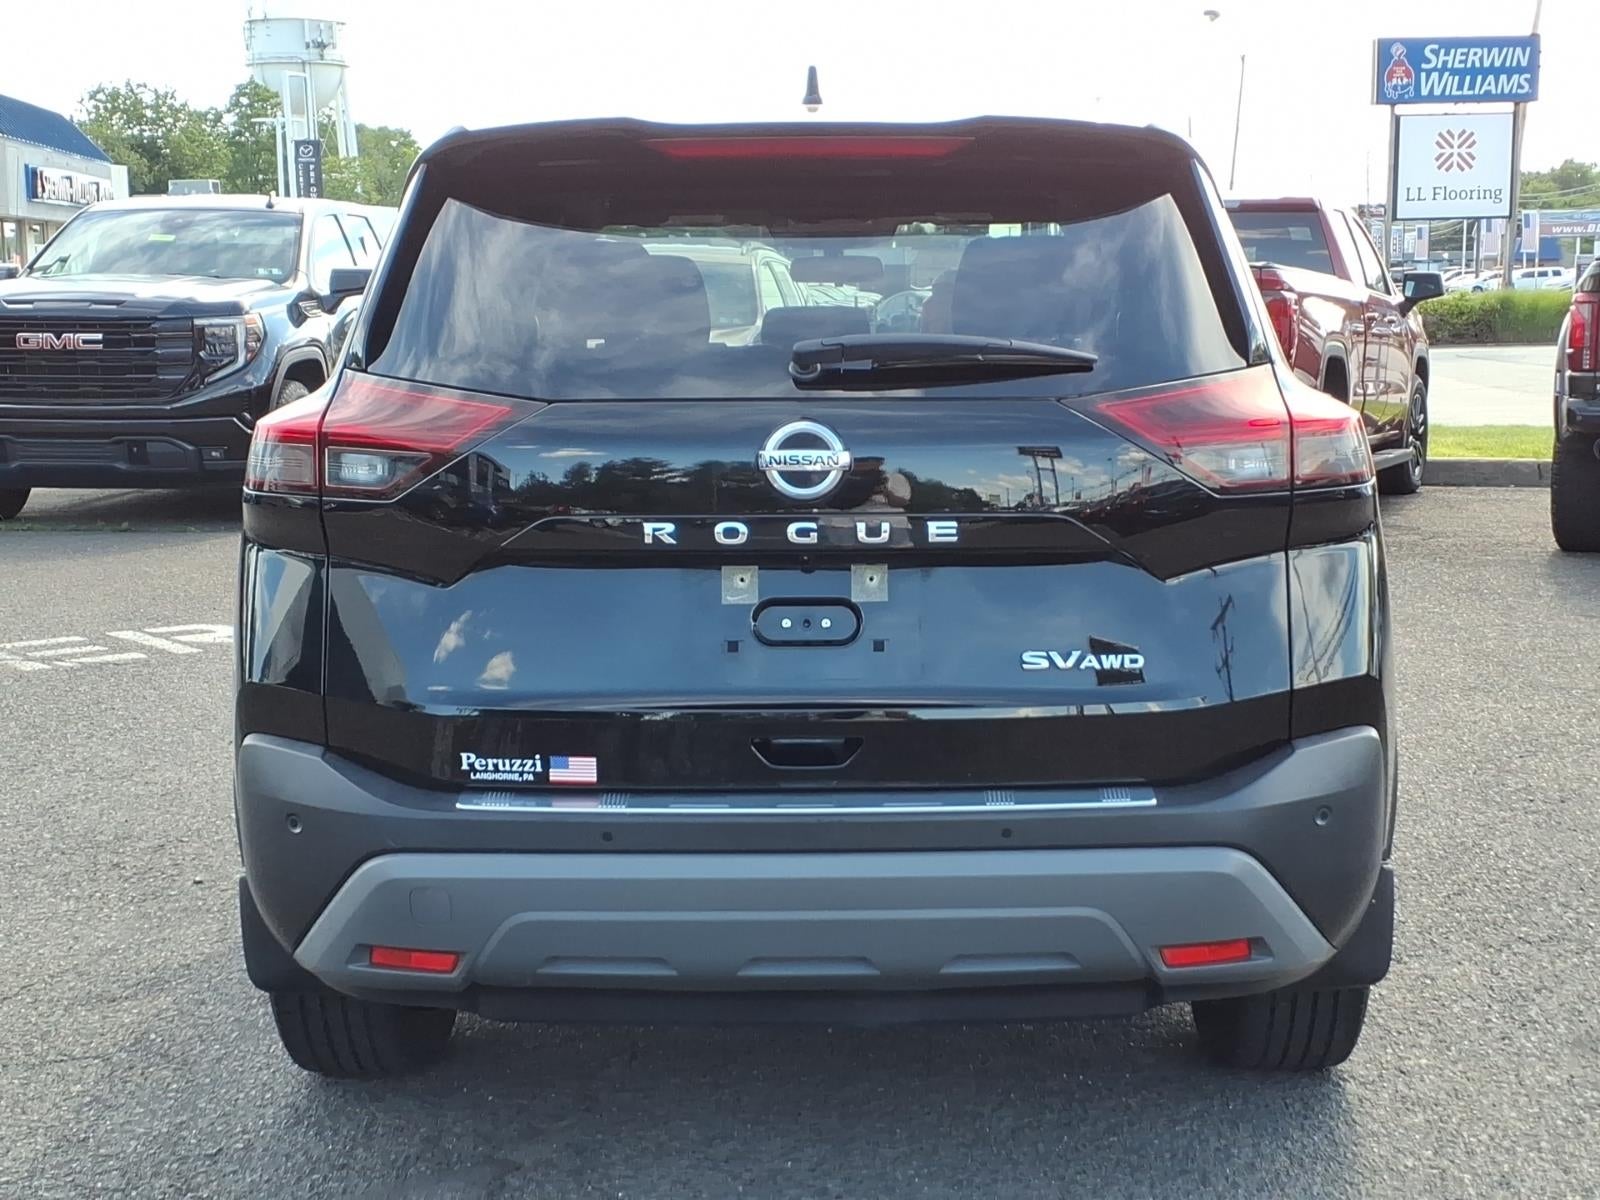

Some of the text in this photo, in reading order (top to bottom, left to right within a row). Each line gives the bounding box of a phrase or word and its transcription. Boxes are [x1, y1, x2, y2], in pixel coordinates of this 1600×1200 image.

[1421, 43, 1531, 69] SHERWIN
[1420, 71, 1531, 96] WILLIAMS
[1405, 185, 1504, 204] LL Flooring
[15, 332, 103, 350] GMC
[768, 454, 840, 467] NISSAN
[642, 521, 959, 545] ROGUE
[460, 752, 543, 772] Peruzzi
[523, 773, 534, 781] PA
